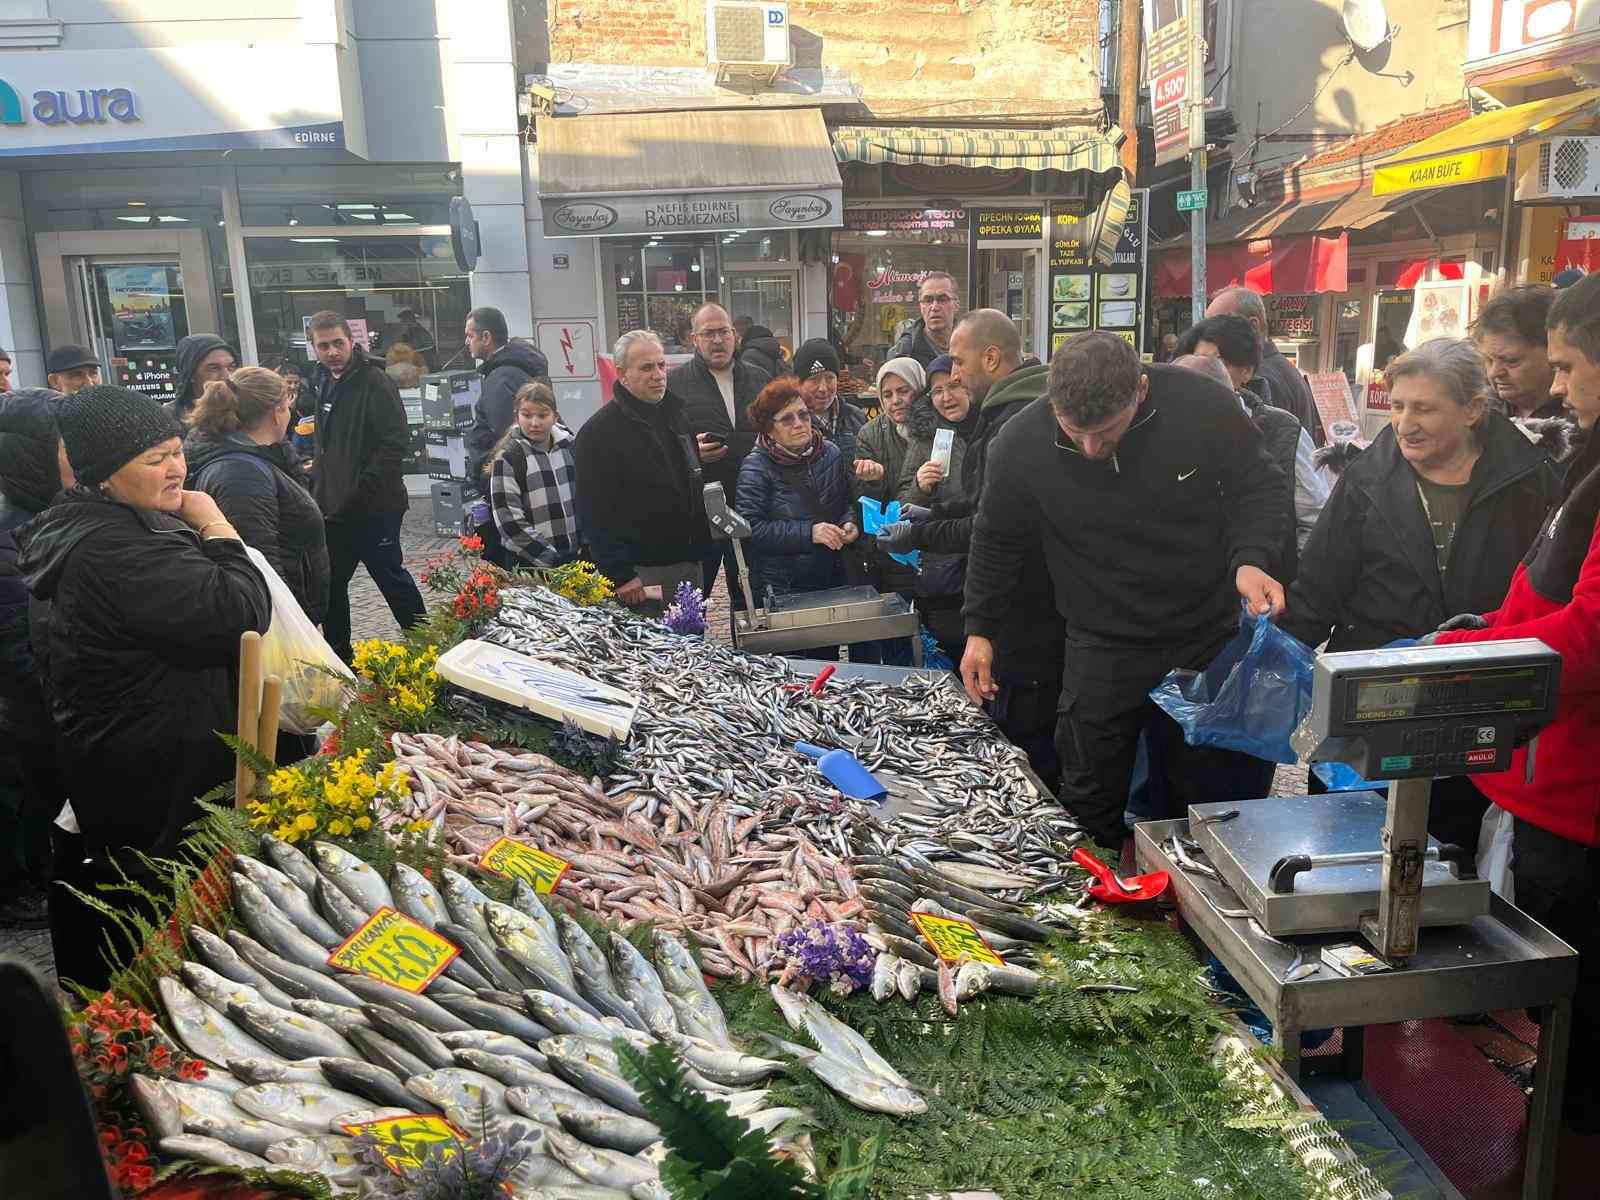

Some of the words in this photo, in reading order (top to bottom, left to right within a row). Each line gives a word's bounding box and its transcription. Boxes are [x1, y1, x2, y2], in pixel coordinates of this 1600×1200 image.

[32, 88, 141, 124] aura
[1409, 166, 1435, 184] KAAN
[1436, 160, 1462, 179] BÜFE
[144, 371, 170, 380] iPhone
[1478, 729, 1495, 742] CE
